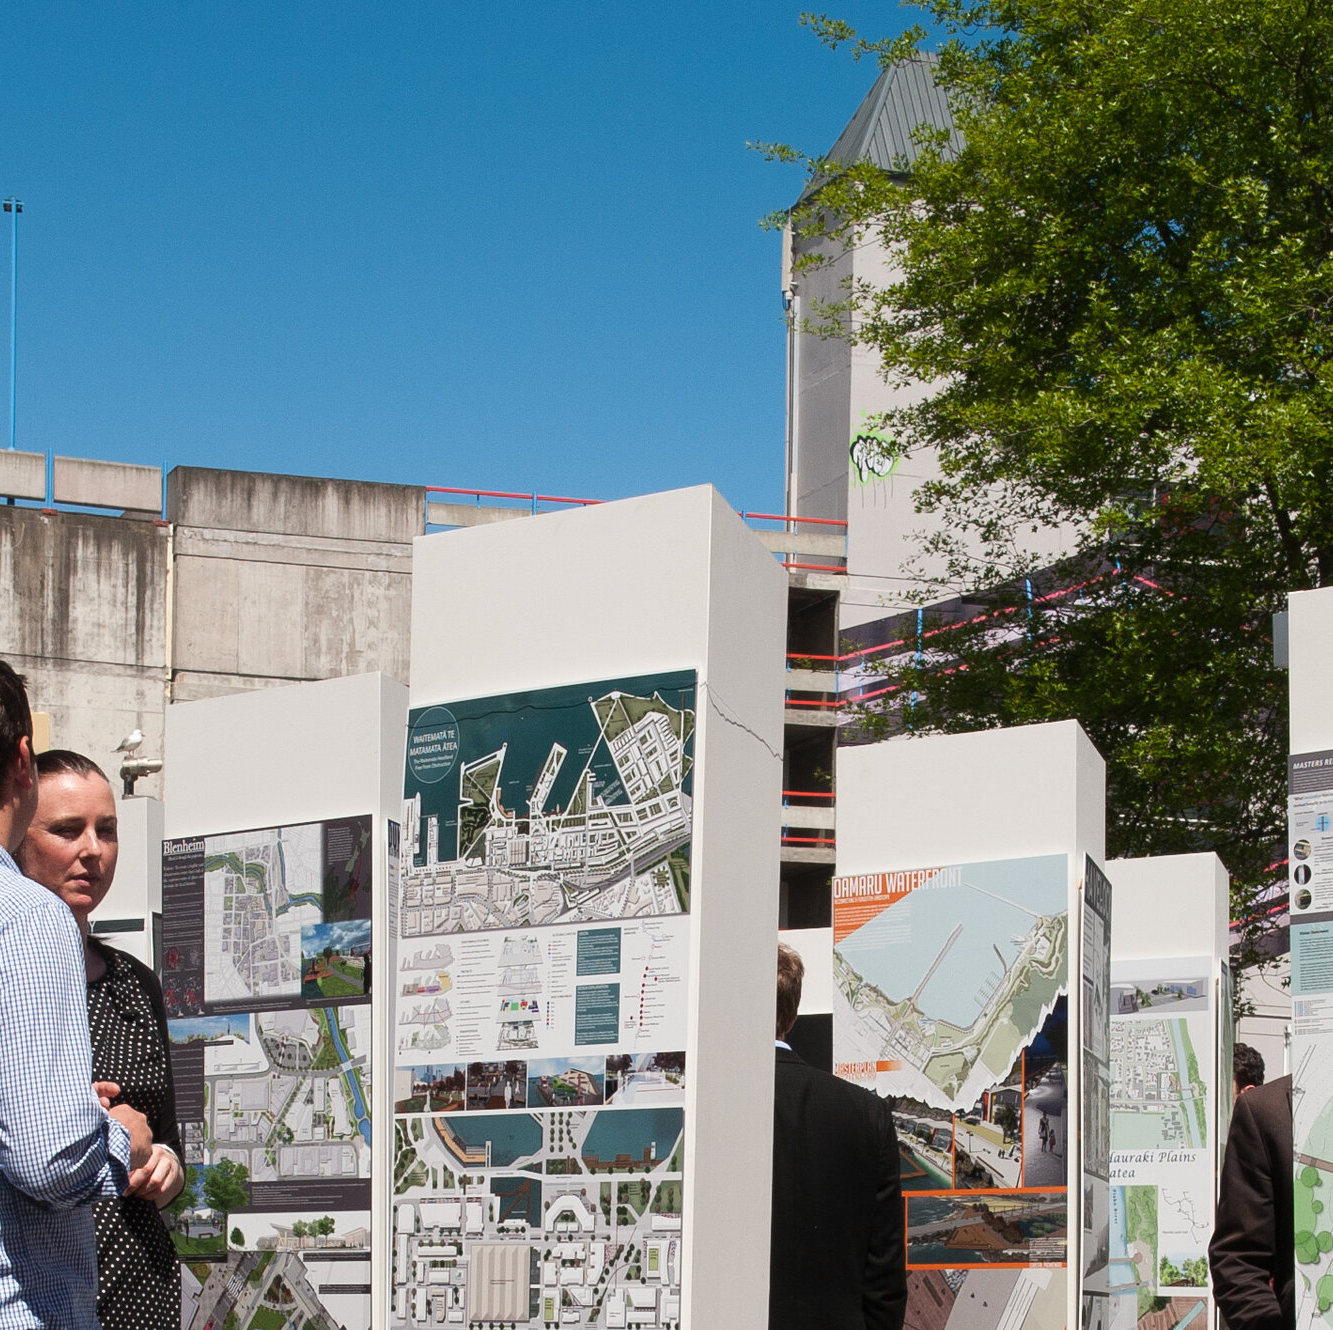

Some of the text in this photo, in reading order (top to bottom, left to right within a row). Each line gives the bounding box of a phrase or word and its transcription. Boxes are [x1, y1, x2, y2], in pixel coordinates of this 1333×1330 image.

[1292, 760, 1323, 769] MASTERS
[163, 838, 204, 856] Blenheim
[833, 866, 963, 898] OAMARU WATERFRONT
[1158, 1150, 1196, 1164] Plains
[1109, 1167, 1135, 1178] atea
